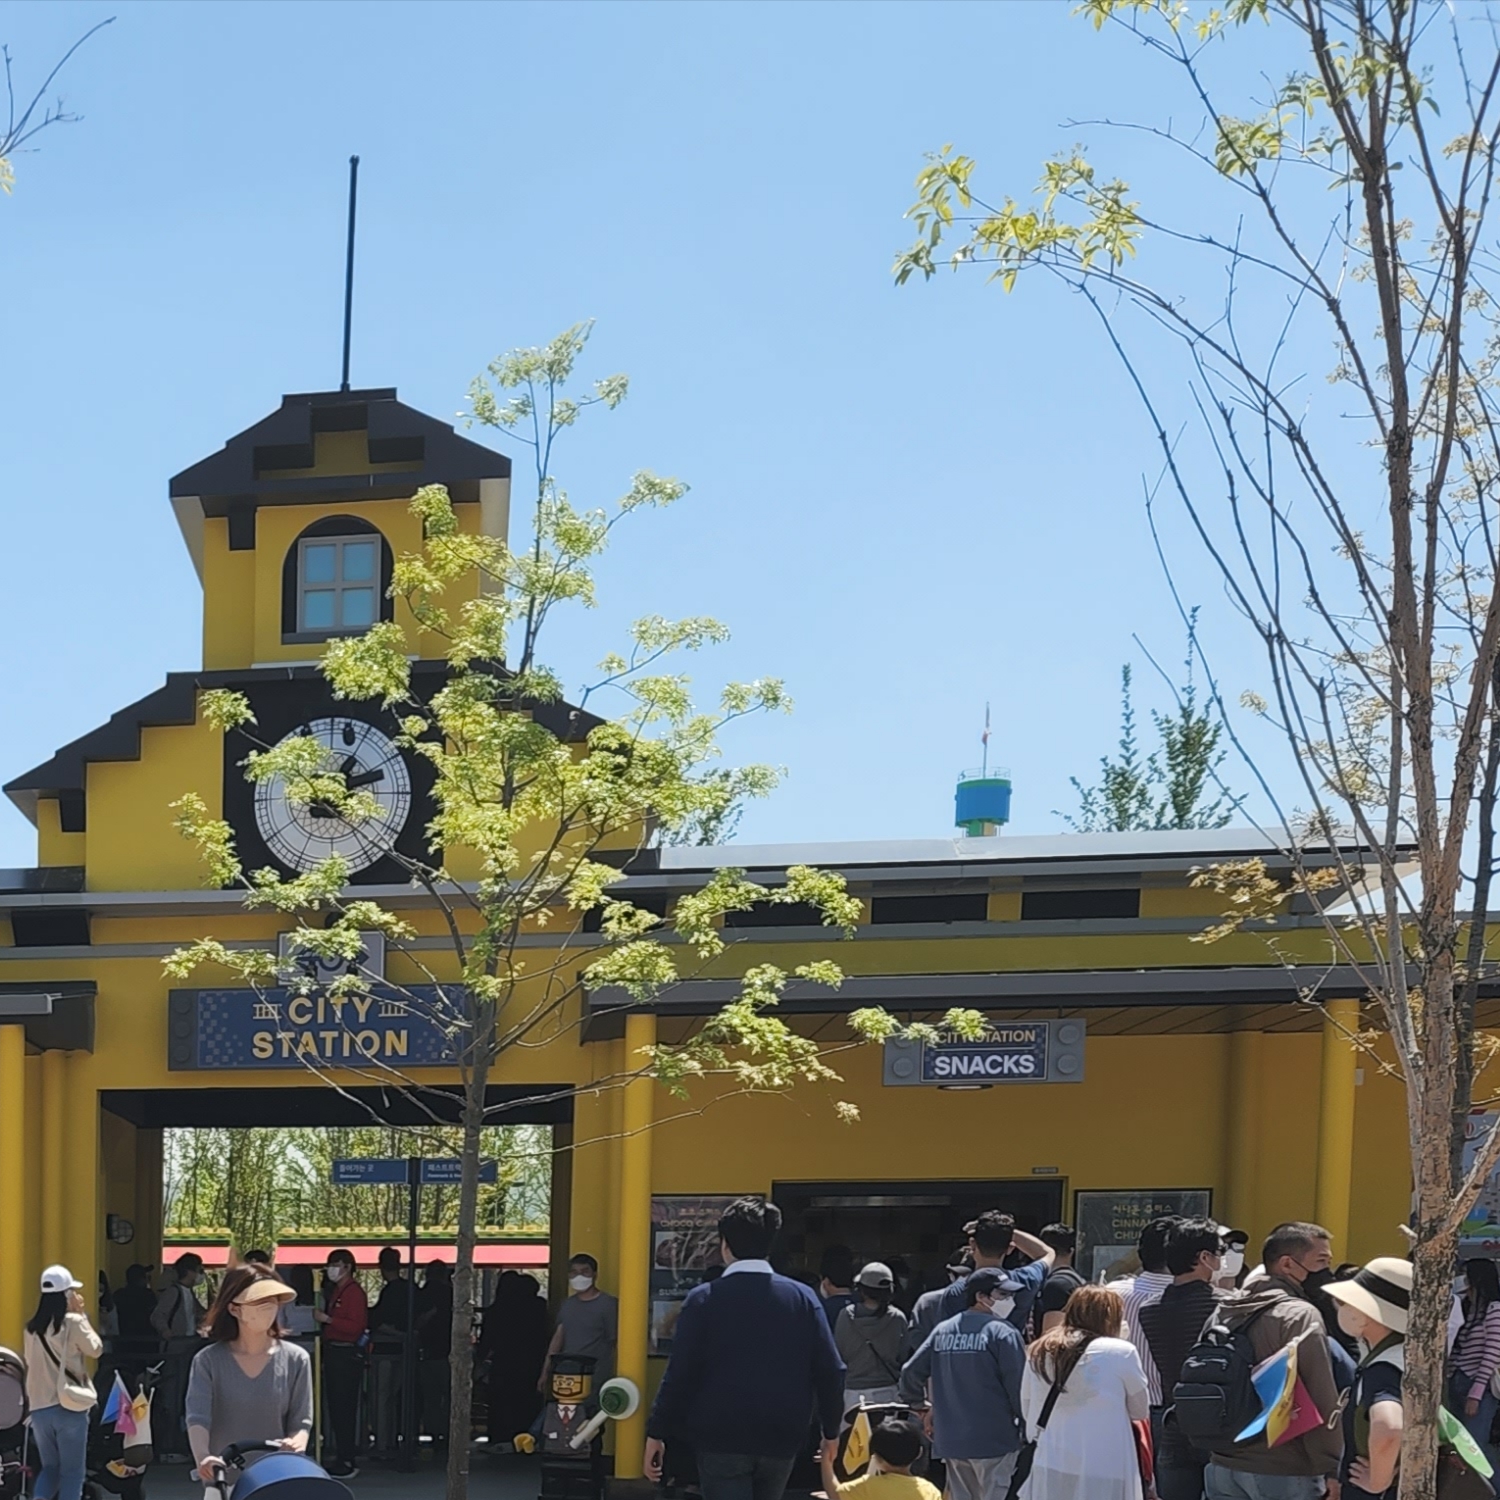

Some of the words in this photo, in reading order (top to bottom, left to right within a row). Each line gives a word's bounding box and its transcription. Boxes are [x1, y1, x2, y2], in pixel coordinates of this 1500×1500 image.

[288, 997, 373, 1025] CITY
[252, 1029, 408, 1059] STATION
[934, 1054, 1035, 1075] SNACKS
